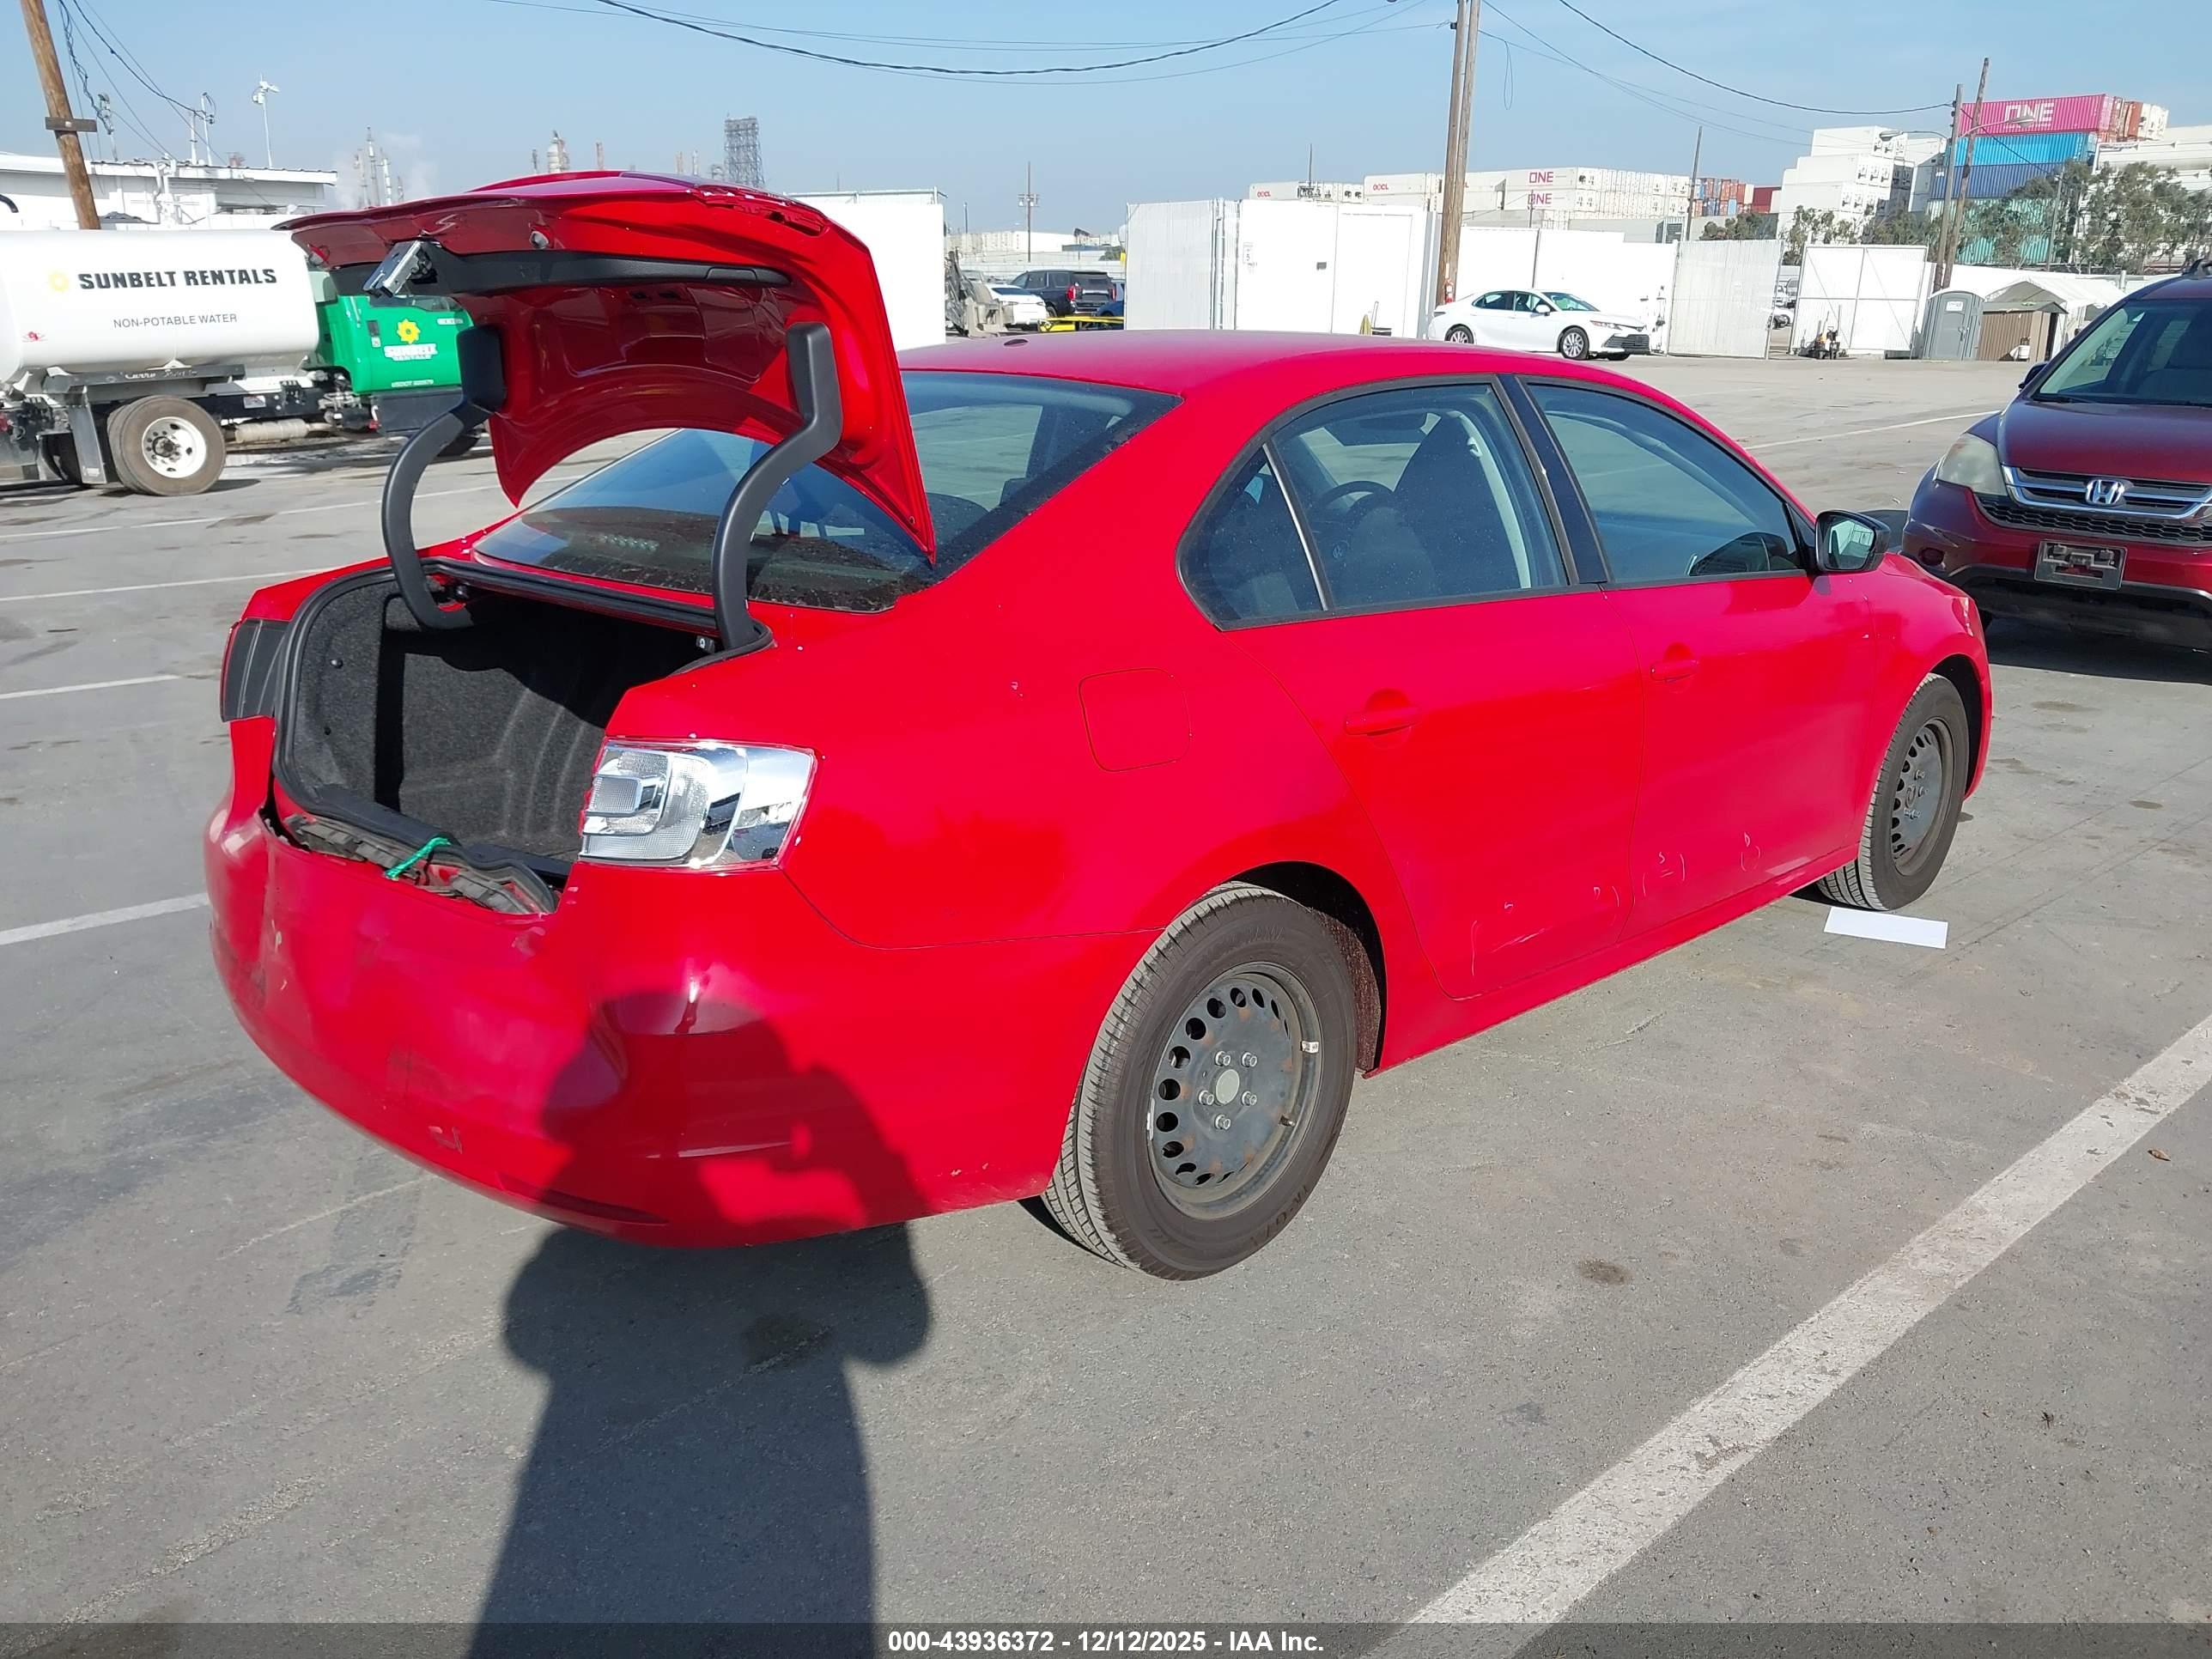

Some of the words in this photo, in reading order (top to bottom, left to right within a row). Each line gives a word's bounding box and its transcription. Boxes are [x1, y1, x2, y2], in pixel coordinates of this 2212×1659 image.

[2004, 102, 2055, 122] ONE
[1528, 171, 1554, 184] ONE
[1527, 192, 1553, 205] ONE
[78, 271, 176, 289] SUNBELT
[183, 269, 277, 286] RENTALS
[112, 315, 198, 329] NON-POTABLE
[198, 313, 238, 324] WATER
